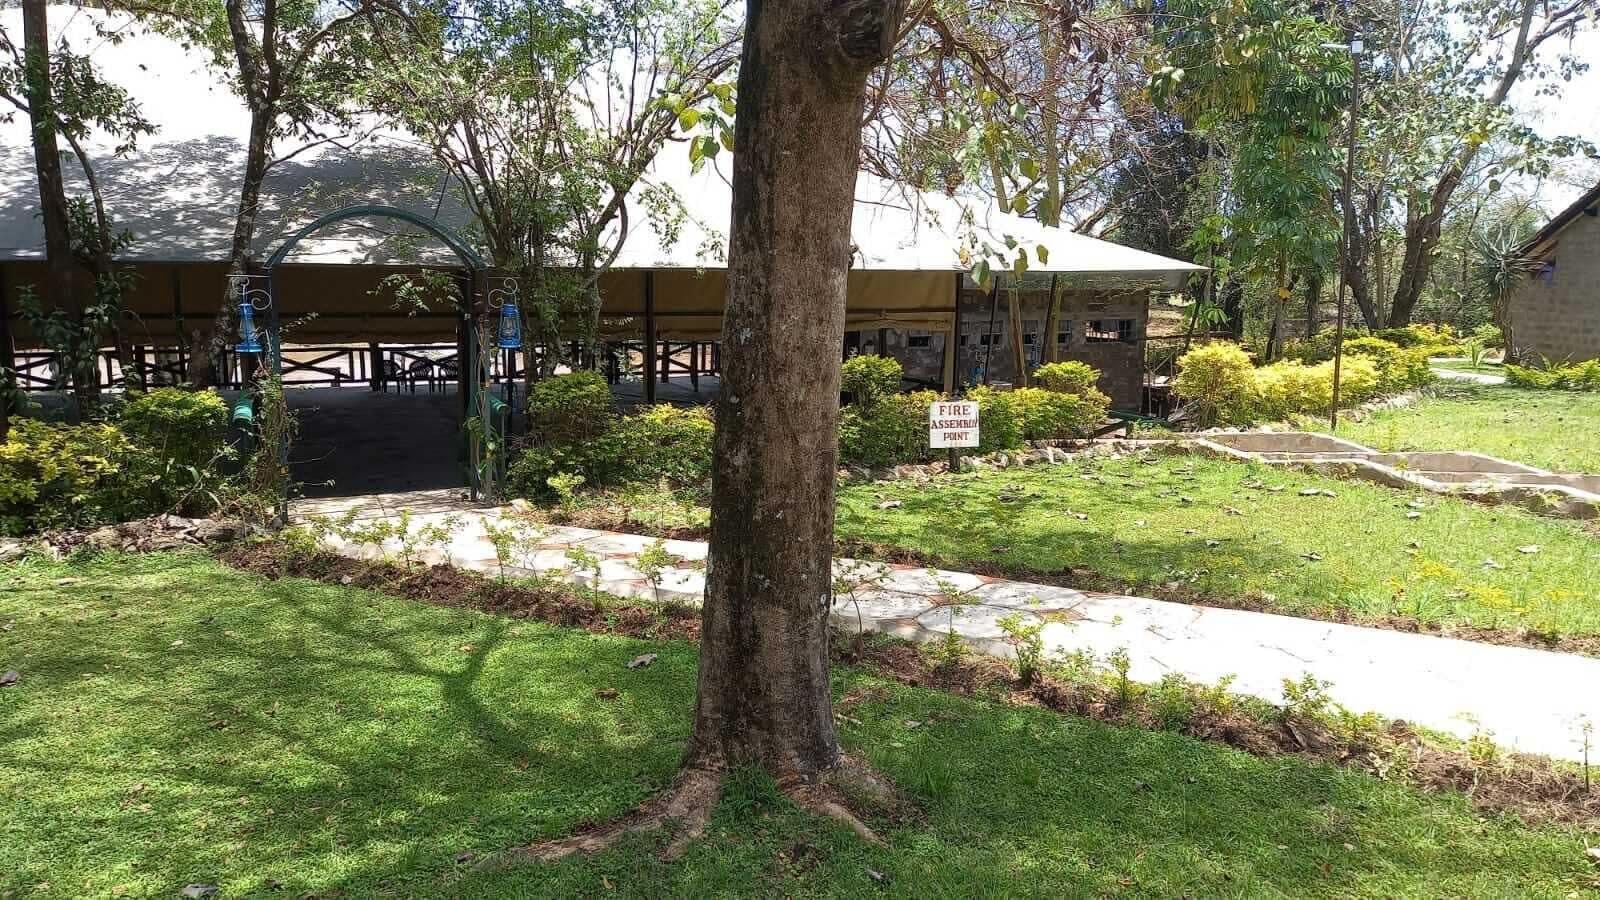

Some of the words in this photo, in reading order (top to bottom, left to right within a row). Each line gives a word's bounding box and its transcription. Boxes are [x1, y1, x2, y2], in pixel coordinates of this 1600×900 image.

[939, 404, 971, 416] FIRE
[931, 416, 978, 429] ASSEMBLY
[943, 431, 969, 441] POINT
